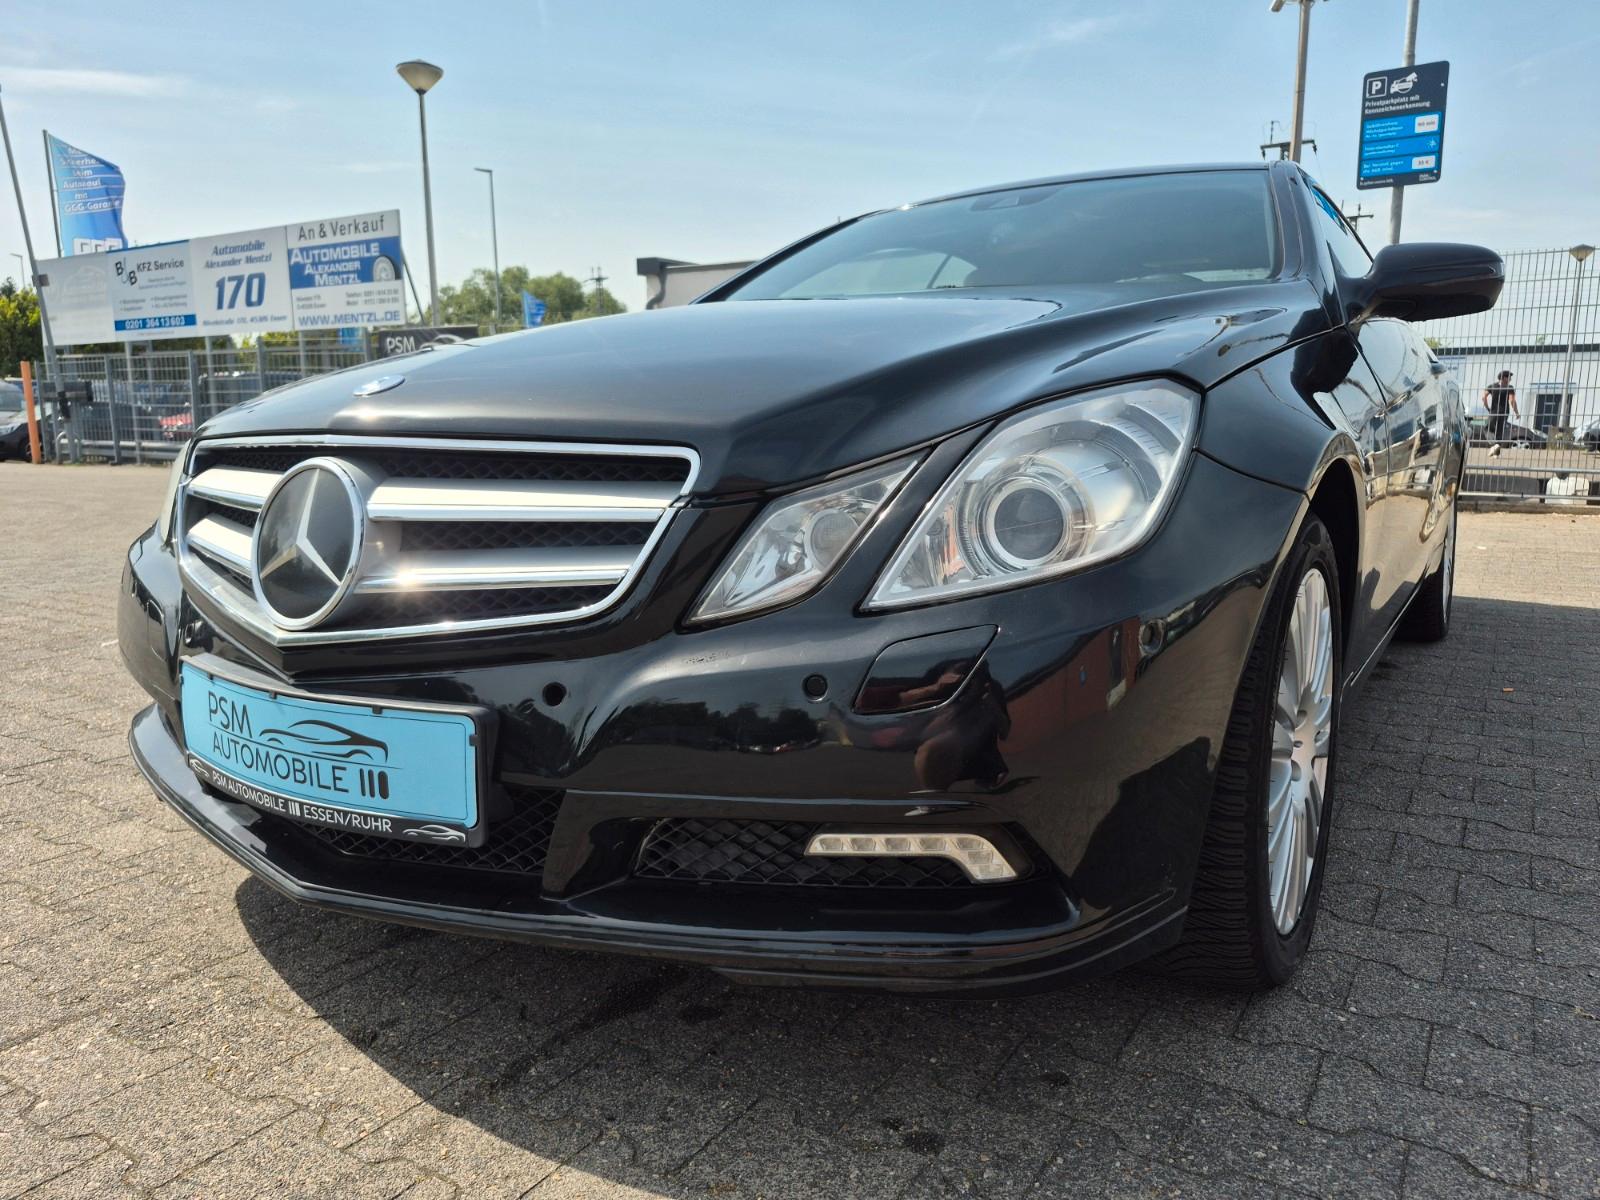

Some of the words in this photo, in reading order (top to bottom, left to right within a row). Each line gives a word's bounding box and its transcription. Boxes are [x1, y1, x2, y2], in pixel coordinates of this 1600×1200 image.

[1365, 97, 1409, 108] Privatparkplatz
[1409, 95, 1420, 103] mit
[298, 225, 316, 241] An
[319, 222, 327, 239] &
[329, 214, 385, 237] Verkauf
[211, 239, 266, 256] Automobile
[290, 242, 380, 265] AUTOMOBILE
[136, 261, 153, 273] KFZ
[153, 258, 185, 271] Service
[204, 257, 243, 269] Alexander
[243, 252, 273, 265] Mentzl
[304, 260, 361, 276] ALEXANDER
[314, 273, 362, 288] MENTZL
[215, 272, 267, 310] 170
[124, 319, 143, 330] 0201
[298, 310, 401, 327] WWW.MENTZL.DE
[386, 335, 417, 354] PSM
[208, 690, 254, 739] PSM
[212, 731, 350, 794] AUTOMOBILE
[211, 770, 229, 793] PSM
[228, 778, 286, 812] AUTOMOBILE
[303, 804, 394, 834] ESSEN/RUHR
